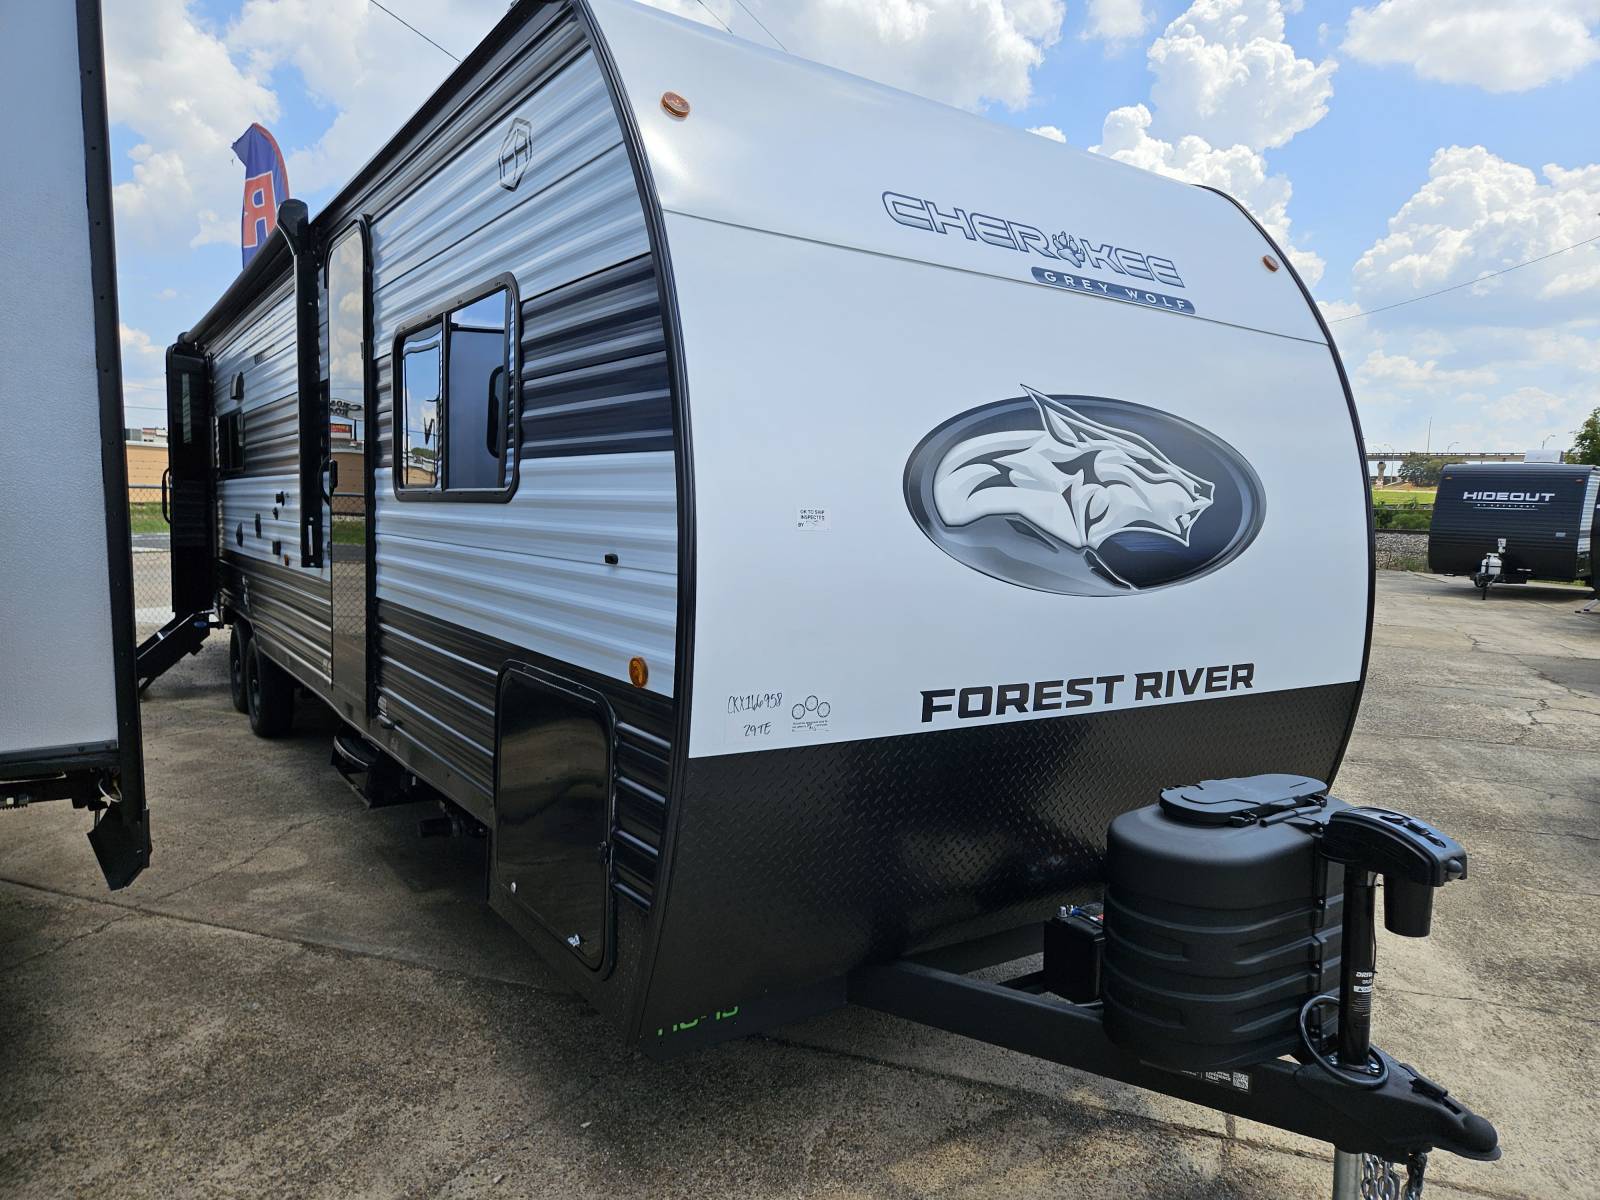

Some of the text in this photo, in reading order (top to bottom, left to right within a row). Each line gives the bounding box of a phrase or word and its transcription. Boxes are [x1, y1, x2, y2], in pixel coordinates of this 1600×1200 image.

[1044, 270, 1186, 311] GREY WOLF
[1462, 491, 1556, 502] HIDEOUT
[919, 662, 1255, 723] FOREST RIVER
